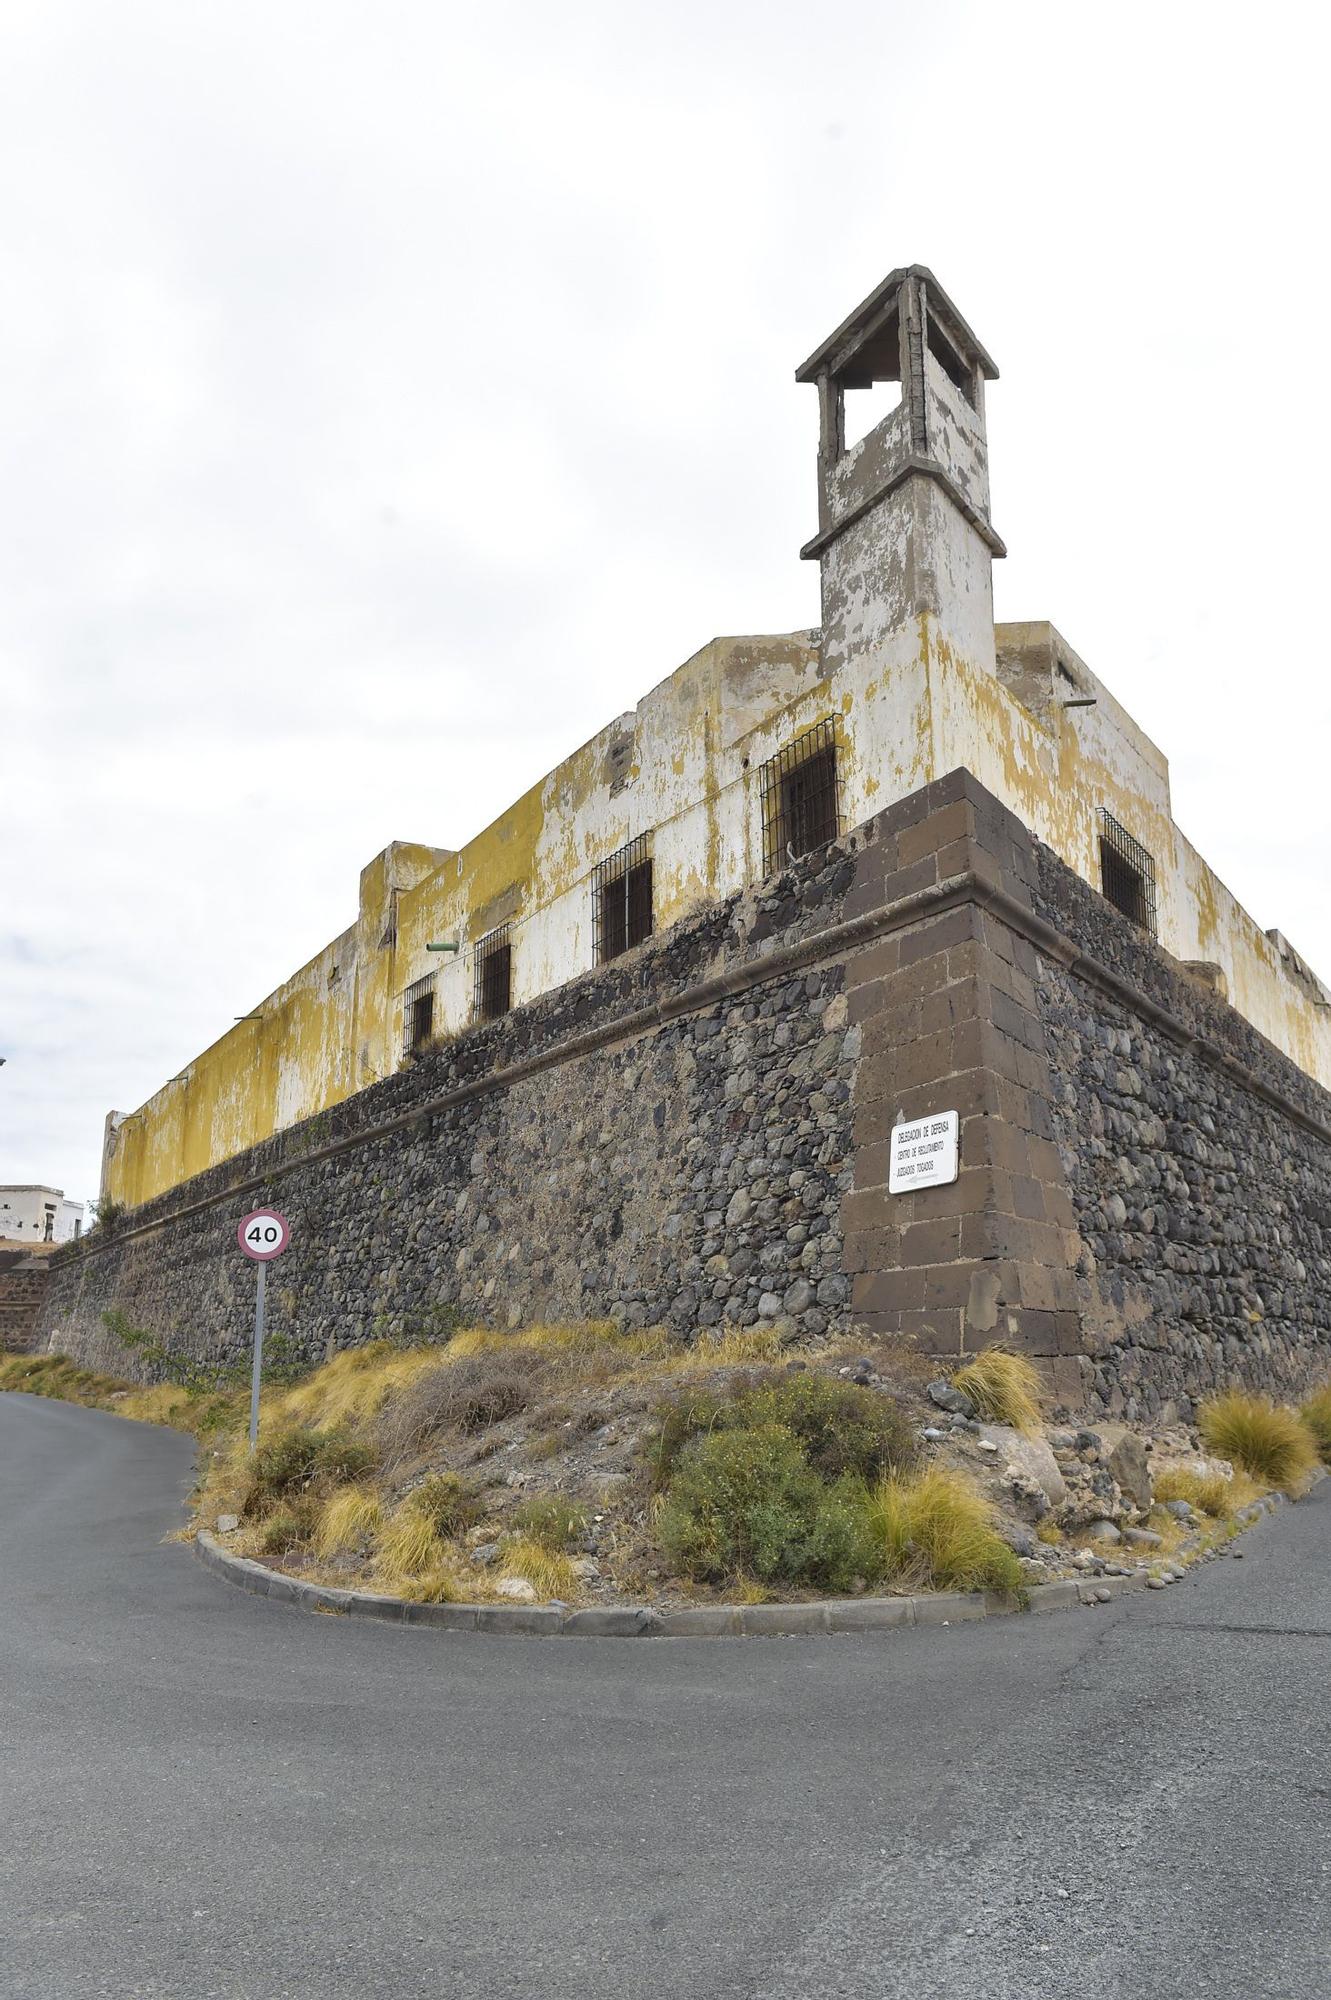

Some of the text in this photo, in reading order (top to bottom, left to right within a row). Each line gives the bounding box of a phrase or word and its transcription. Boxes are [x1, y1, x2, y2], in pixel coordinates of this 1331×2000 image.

[923, 1125, 929, 1138] DE
[931, 1120, 949, 1135] DEFENSA
[897, 1148, 910, 1160] CENTRO
[911, 1146, 917, 1157] DE
[916, 1160, 934, 1173] TOGADOS
[247, 1226, 278, 1243] 40
